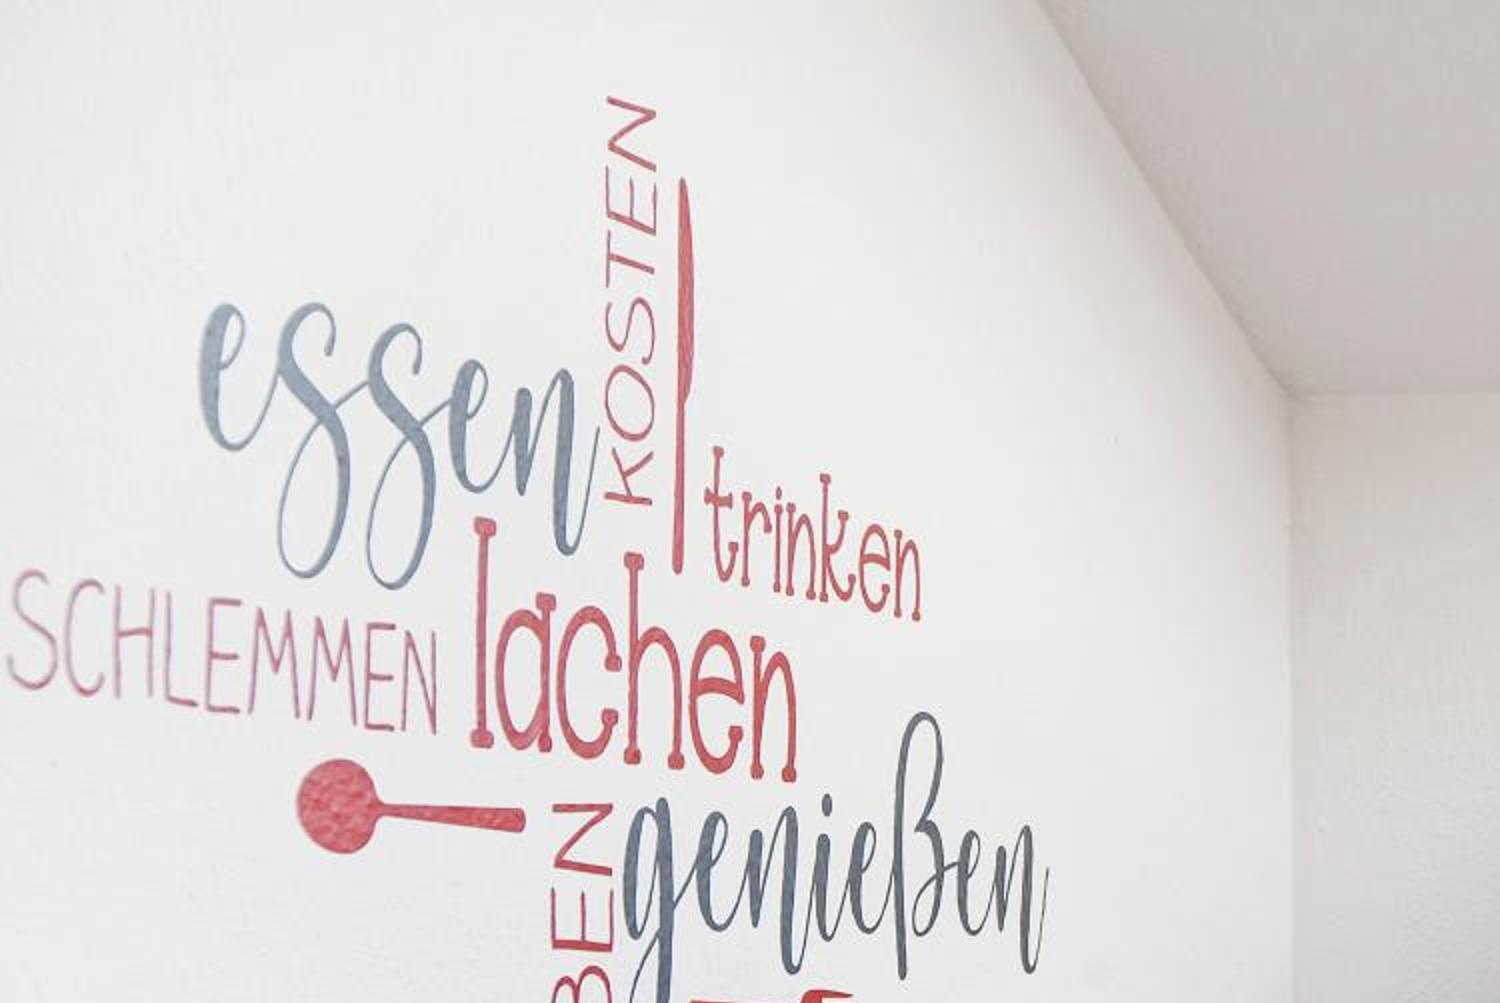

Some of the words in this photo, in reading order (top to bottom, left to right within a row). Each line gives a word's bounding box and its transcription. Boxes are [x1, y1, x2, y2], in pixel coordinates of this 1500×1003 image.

[604, 96, 657, 506] KOSTEN
[200, 303, 600, 590] essen
[704, 446, 921, 622] trinken
[7, 569, 438, 737] SCHLEMMEN
[472, 516, 798, 784] lachen
